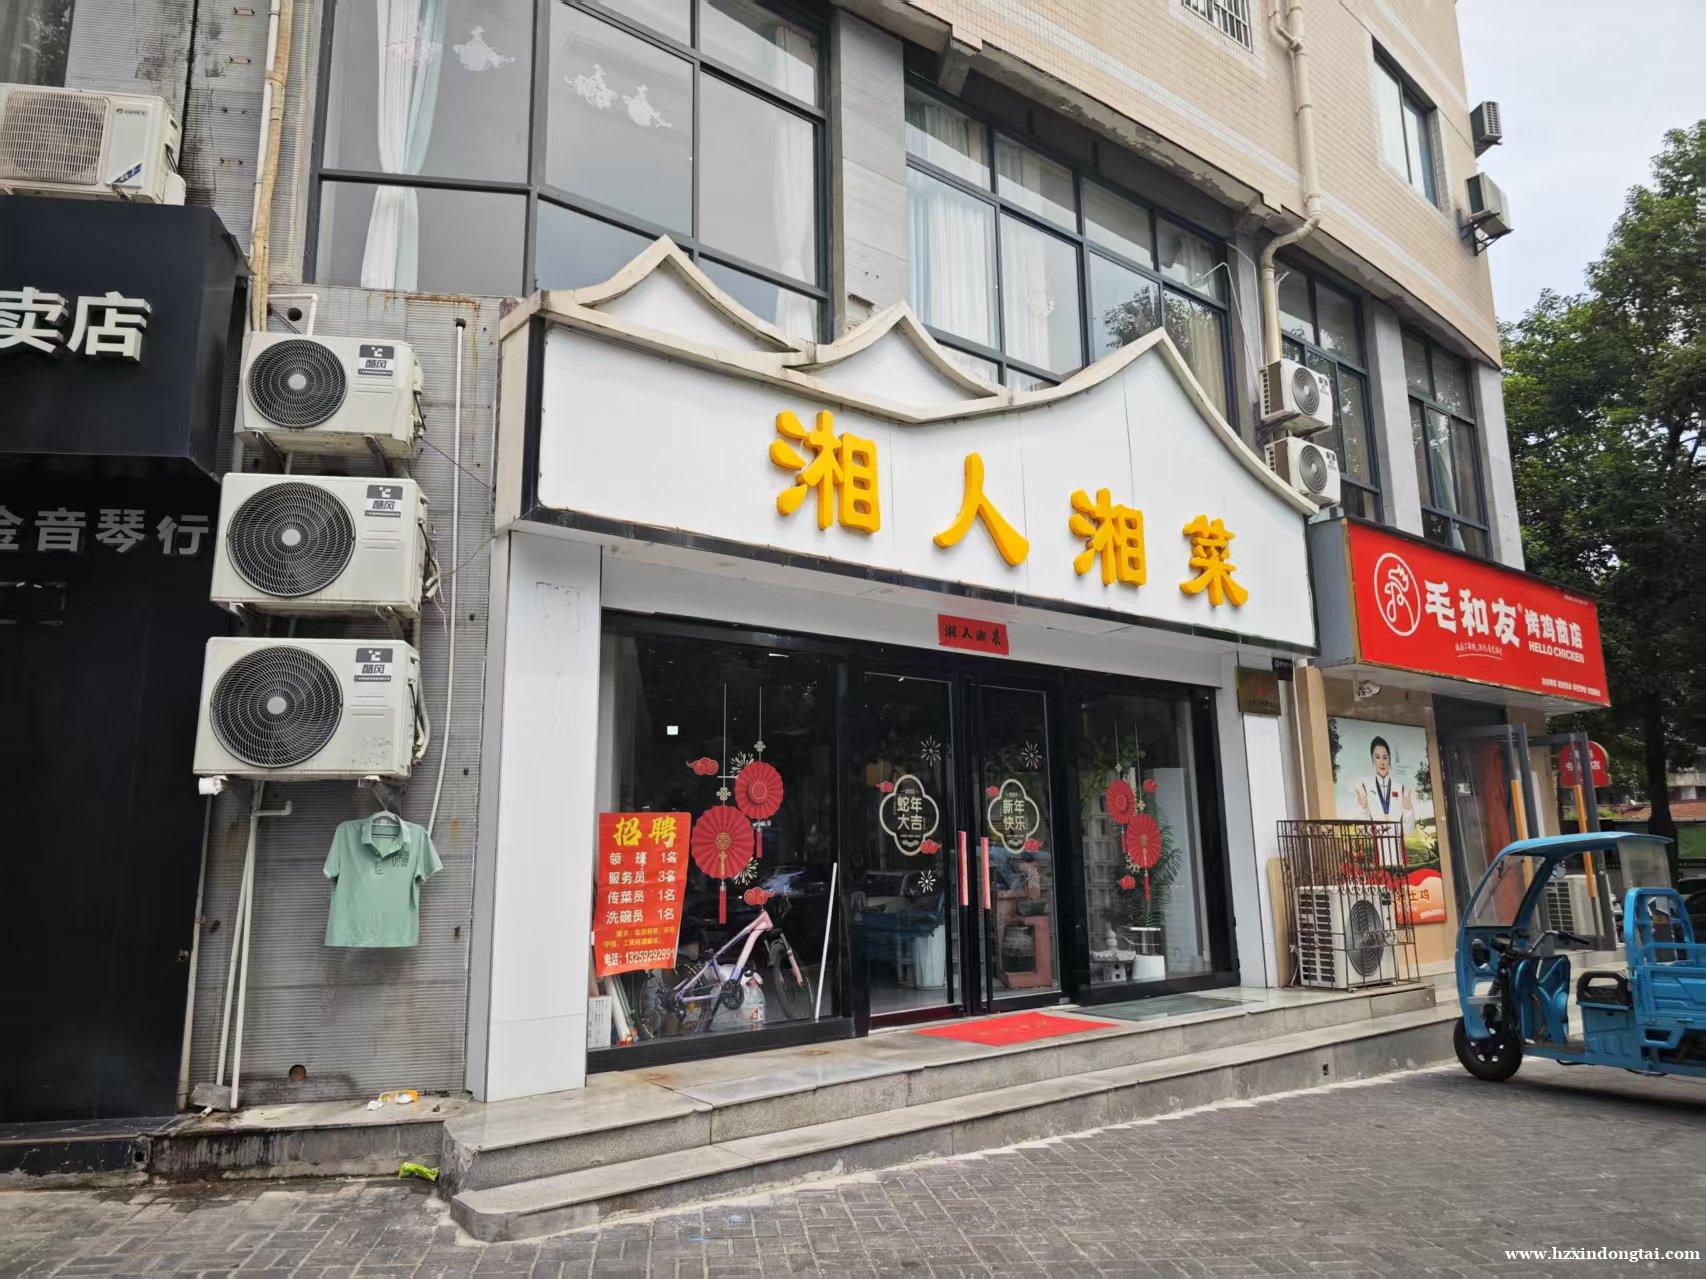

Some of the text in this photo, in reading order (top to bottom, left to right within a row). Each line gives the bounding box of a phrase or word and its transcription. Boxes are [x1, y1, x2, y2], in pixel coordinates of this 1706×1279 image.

[0, 286, 152, 362] 卖店
[768, 408, 1249, 608] 湘人湘菜
[1424, 579, 1520, 648] 毛和友
[944, 623, 1001, 646] 湘人湘菜
[1528, 641, 1585, 664] HELLO CHICKEN
[897, 796, 923, 813] 蛇年
[1002, 799, 1025, 814] 新年
[897, 813, 923, 831] 大吉
[1003, 815, 1026, 831] 快乐
[612, 815, 676, 848] 招聘
[608, 870, 645, 885] 服务员
[607, 889, 675, 904] 传菜员 1名
[606, 908, 675, 925] 洗碗员 1名
